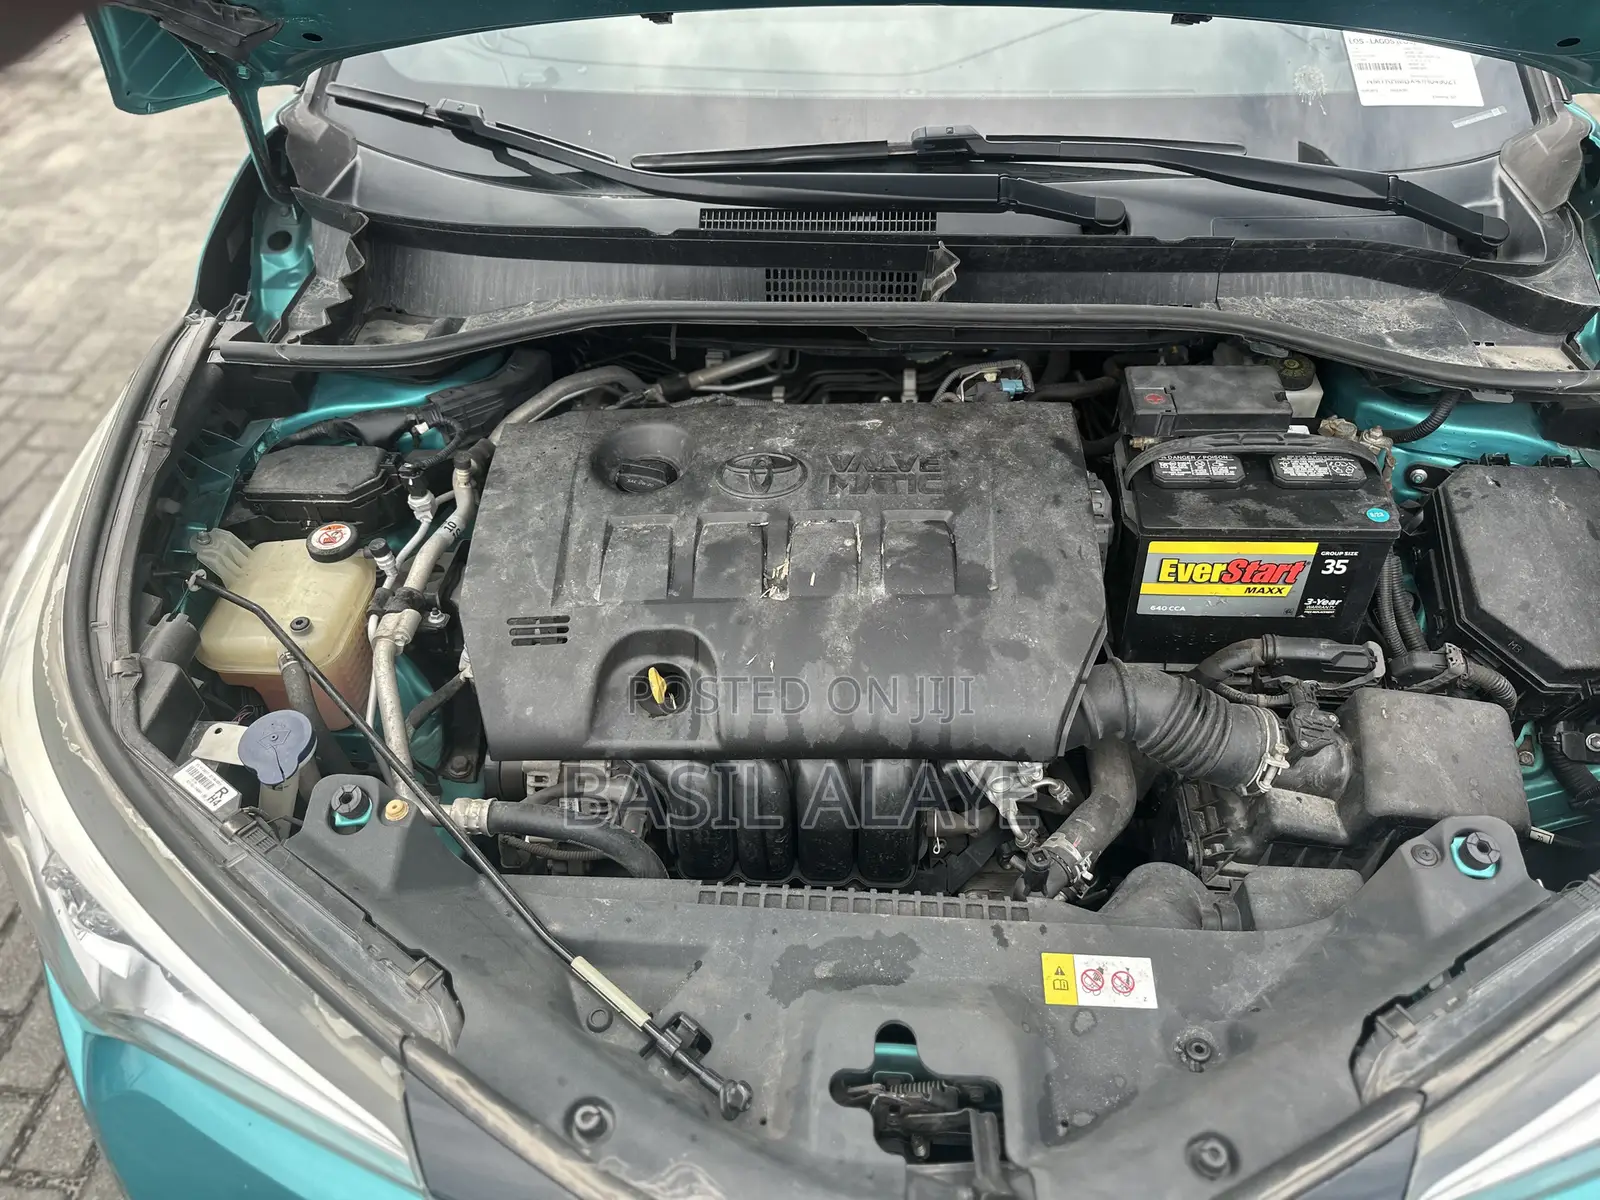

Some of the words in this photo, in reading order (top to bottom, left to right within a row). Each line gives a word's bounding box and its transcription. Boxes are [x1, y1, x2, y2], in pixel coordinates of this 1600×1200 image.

[826, 454, 942, 472] VALVE
[828, 474, 944, 495] MATIC
[1157, 557, 1307, 585] EverStart
[1321, 559, 1349, 575] 35
[1243, 587, 1286, 595] MAXX
[1303, 598, 1343, 606] 3-Year
[214, 786, 229, 798] R
